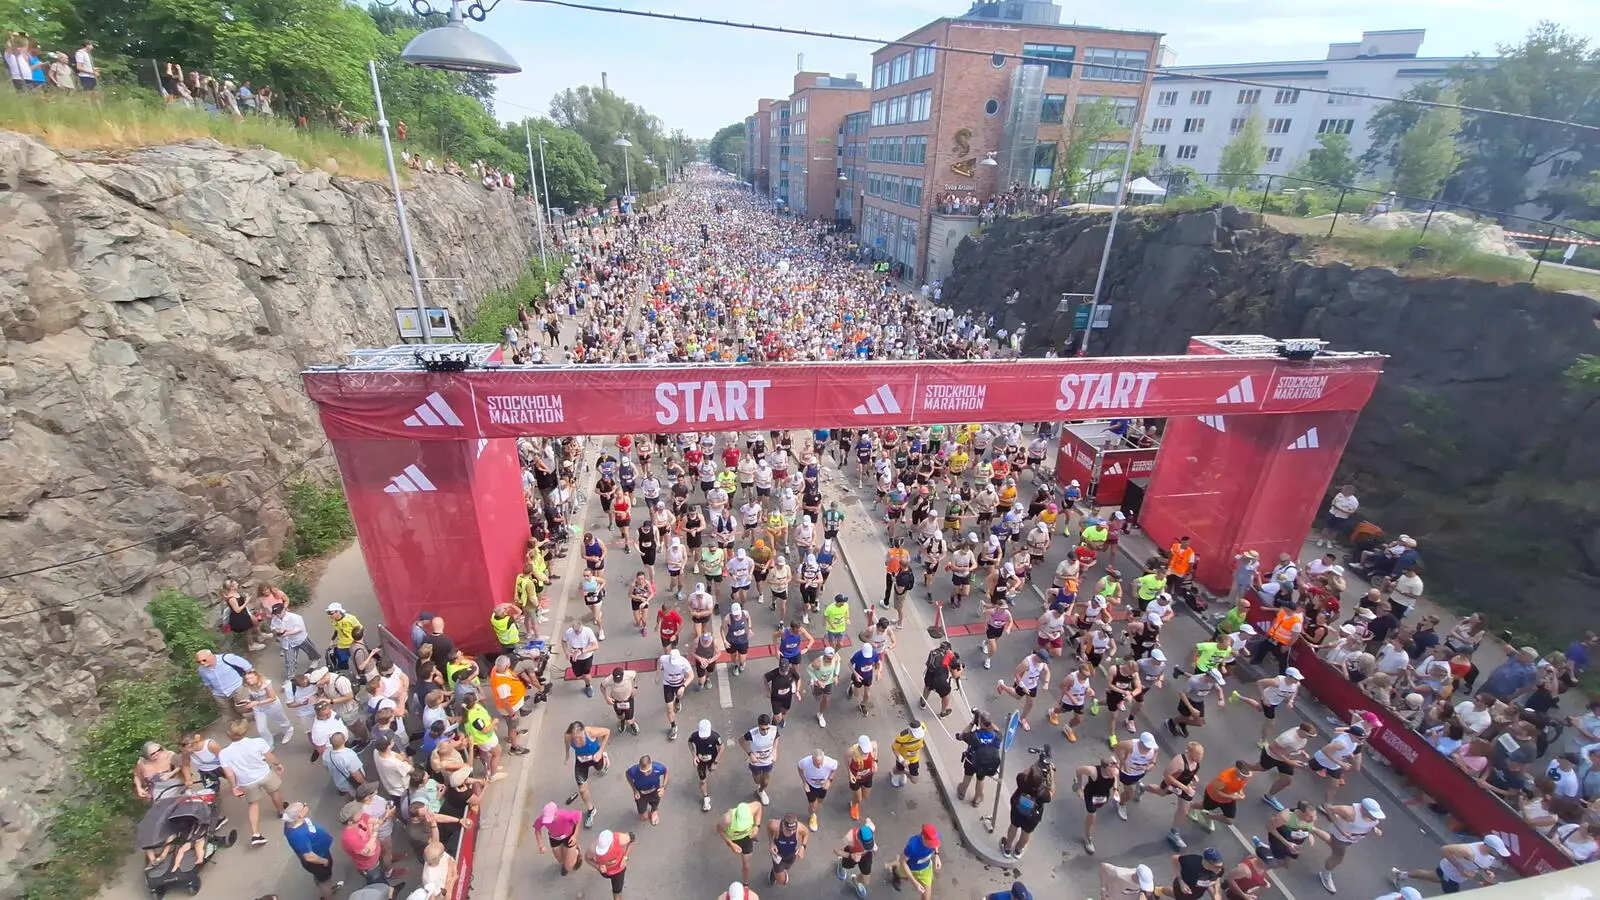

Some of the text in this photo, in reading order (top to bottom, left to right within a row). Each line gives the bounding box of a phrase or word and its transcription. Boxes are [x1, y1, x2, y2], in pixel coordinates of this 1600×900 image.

[1277, 376, 1328, 388] STOCKHOLM
[925, 384, 986, 398] STOCKHOLM
[1056, 372, 1158, 411] START
[1273, 387, 1323, 399] MARATHON
[487, 394, 562, 410] STOCKHOLM
[655, 380, 771, 425] START
[923, 397, 984, 410] MARATHON
[489, 408, 564, 424] MARATHON
